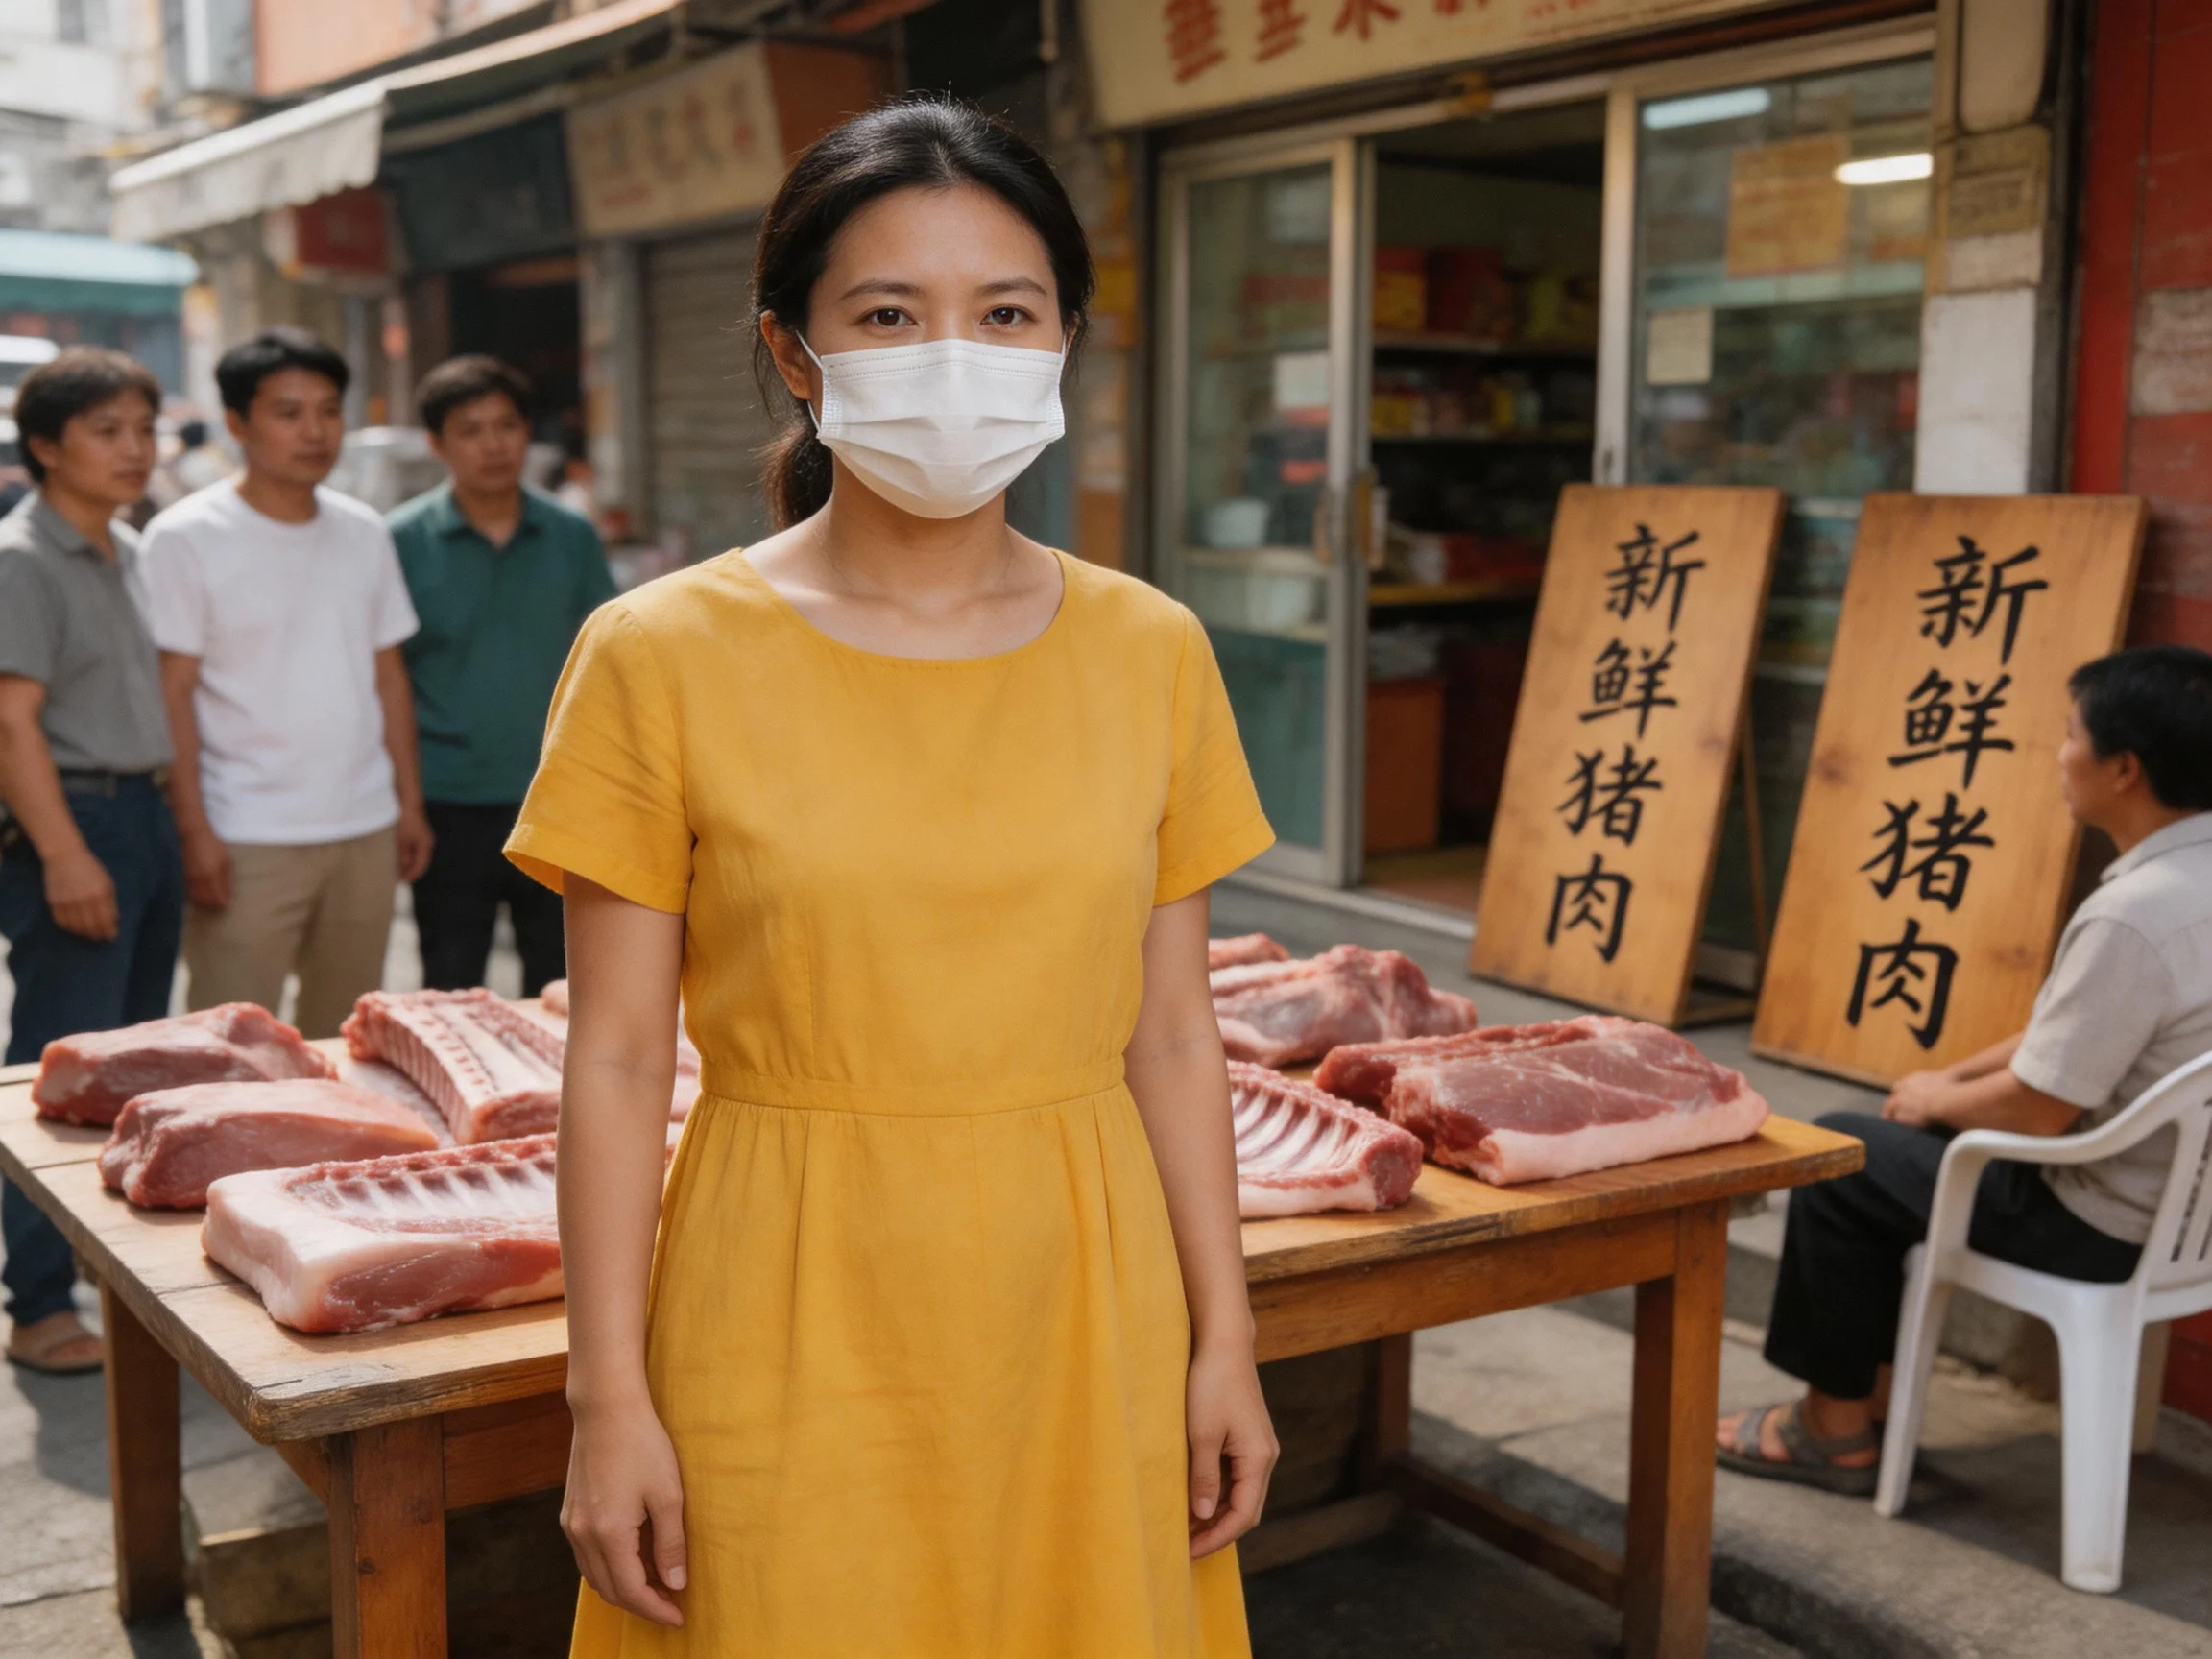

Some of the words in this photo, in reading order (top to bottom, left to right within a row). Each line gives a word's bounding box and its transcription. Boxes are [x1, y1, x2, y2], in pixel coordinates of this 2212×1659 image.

[1545, 524, 1707, 963] 新鲜猪肉
[1846, 536, 2048, 1049] 新鲜猪肉
